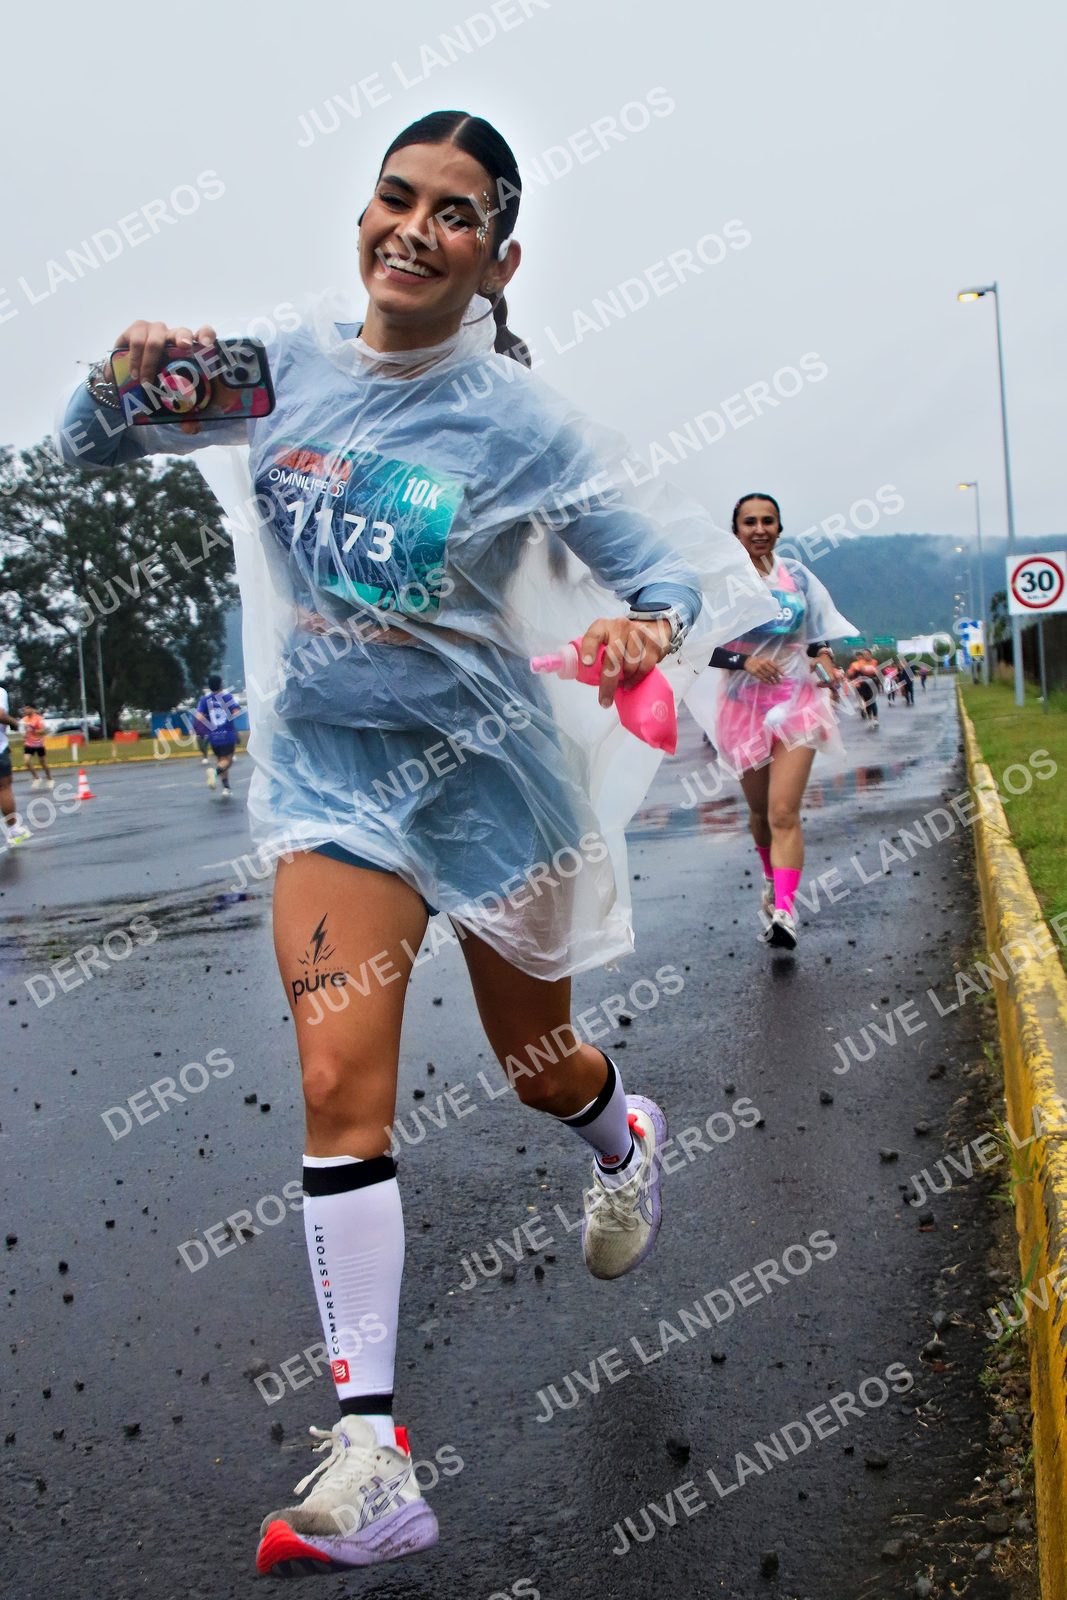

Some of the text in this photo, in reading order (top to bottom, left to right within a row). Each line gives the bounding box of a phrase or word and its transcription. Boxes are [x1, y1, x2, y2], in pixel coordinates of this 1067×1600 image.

[269, 468, 328, 494] OMNILIFE
[402, 477, 443, 510] 10K
[287, 501, 395, 562] 1173
[1021, 570, 1055, 592] 30
[314, 1225, 340, 1355] COMPRESSPORT
